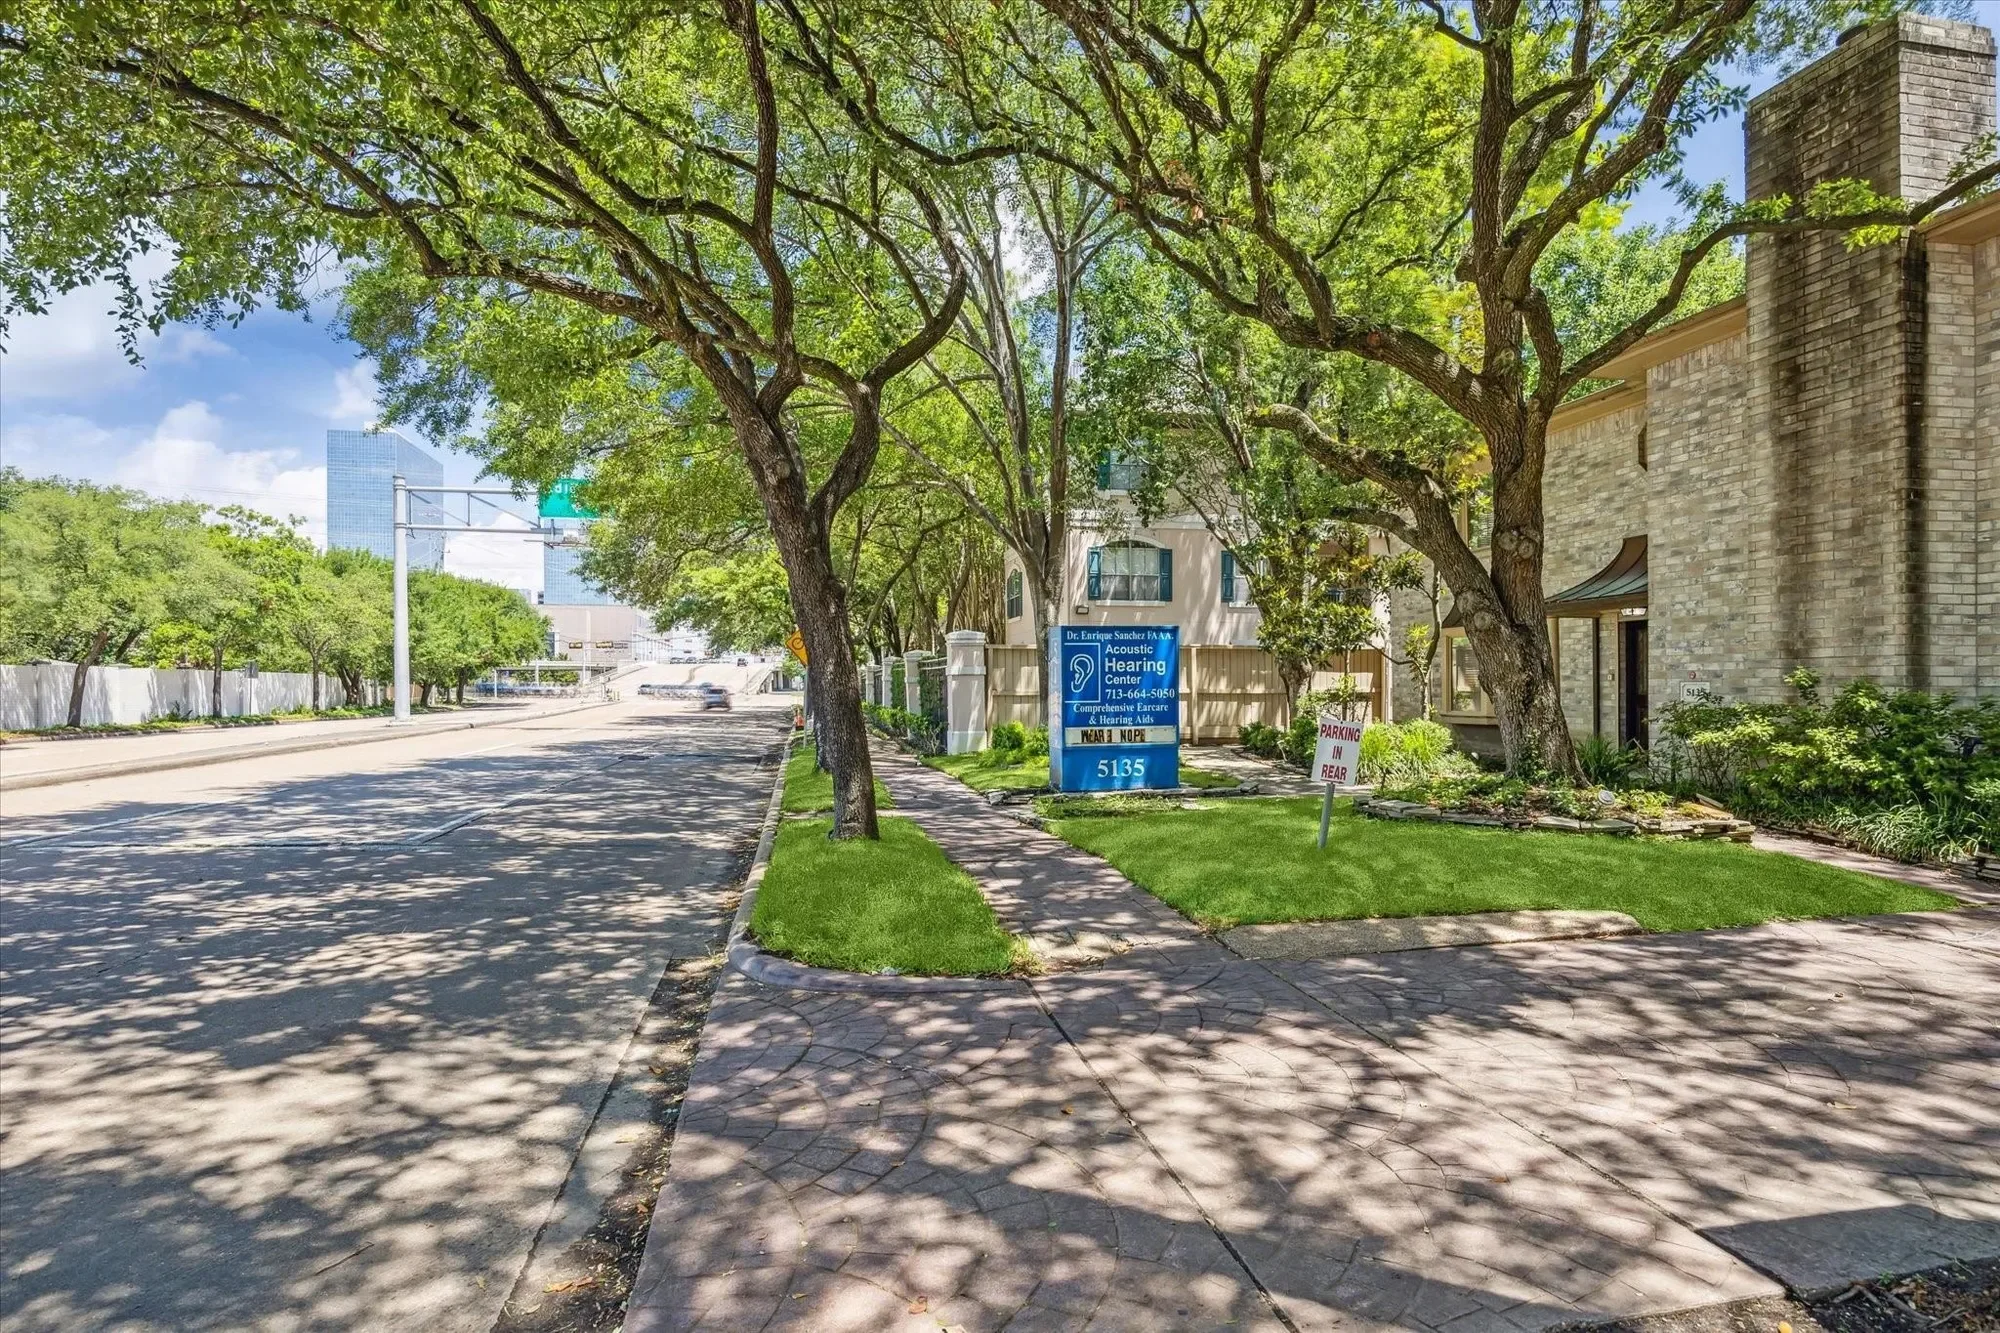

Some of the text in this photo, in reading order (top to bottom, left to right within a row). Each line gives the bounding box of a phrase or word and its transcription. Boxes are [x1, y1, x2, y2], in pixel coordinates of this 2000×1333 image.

[1067, 631, 1079, 640] Dr.
[1081, 631, 1113, 642] Enrique
[1114, 631, 1146, 640] Sanchez
[1105, 644, 1153, 654] Acoustic
[1105, 657, 1166, 675] Hearing
[1105, 674, 1142, 685] Center
[1105, 688, 1175, 699] 713-664-5050
[1073, 703, 1169, 714] Comprehensive Earcare
[1088, 714, 1155, 725] & Hearing Aids
[1320, 724, 1361, 742] PARKING
[1332, 745, 1343, 760] IN
[1097, 758, 1145, 777] 5135
[1321, 764, 1347, 780] REAR
